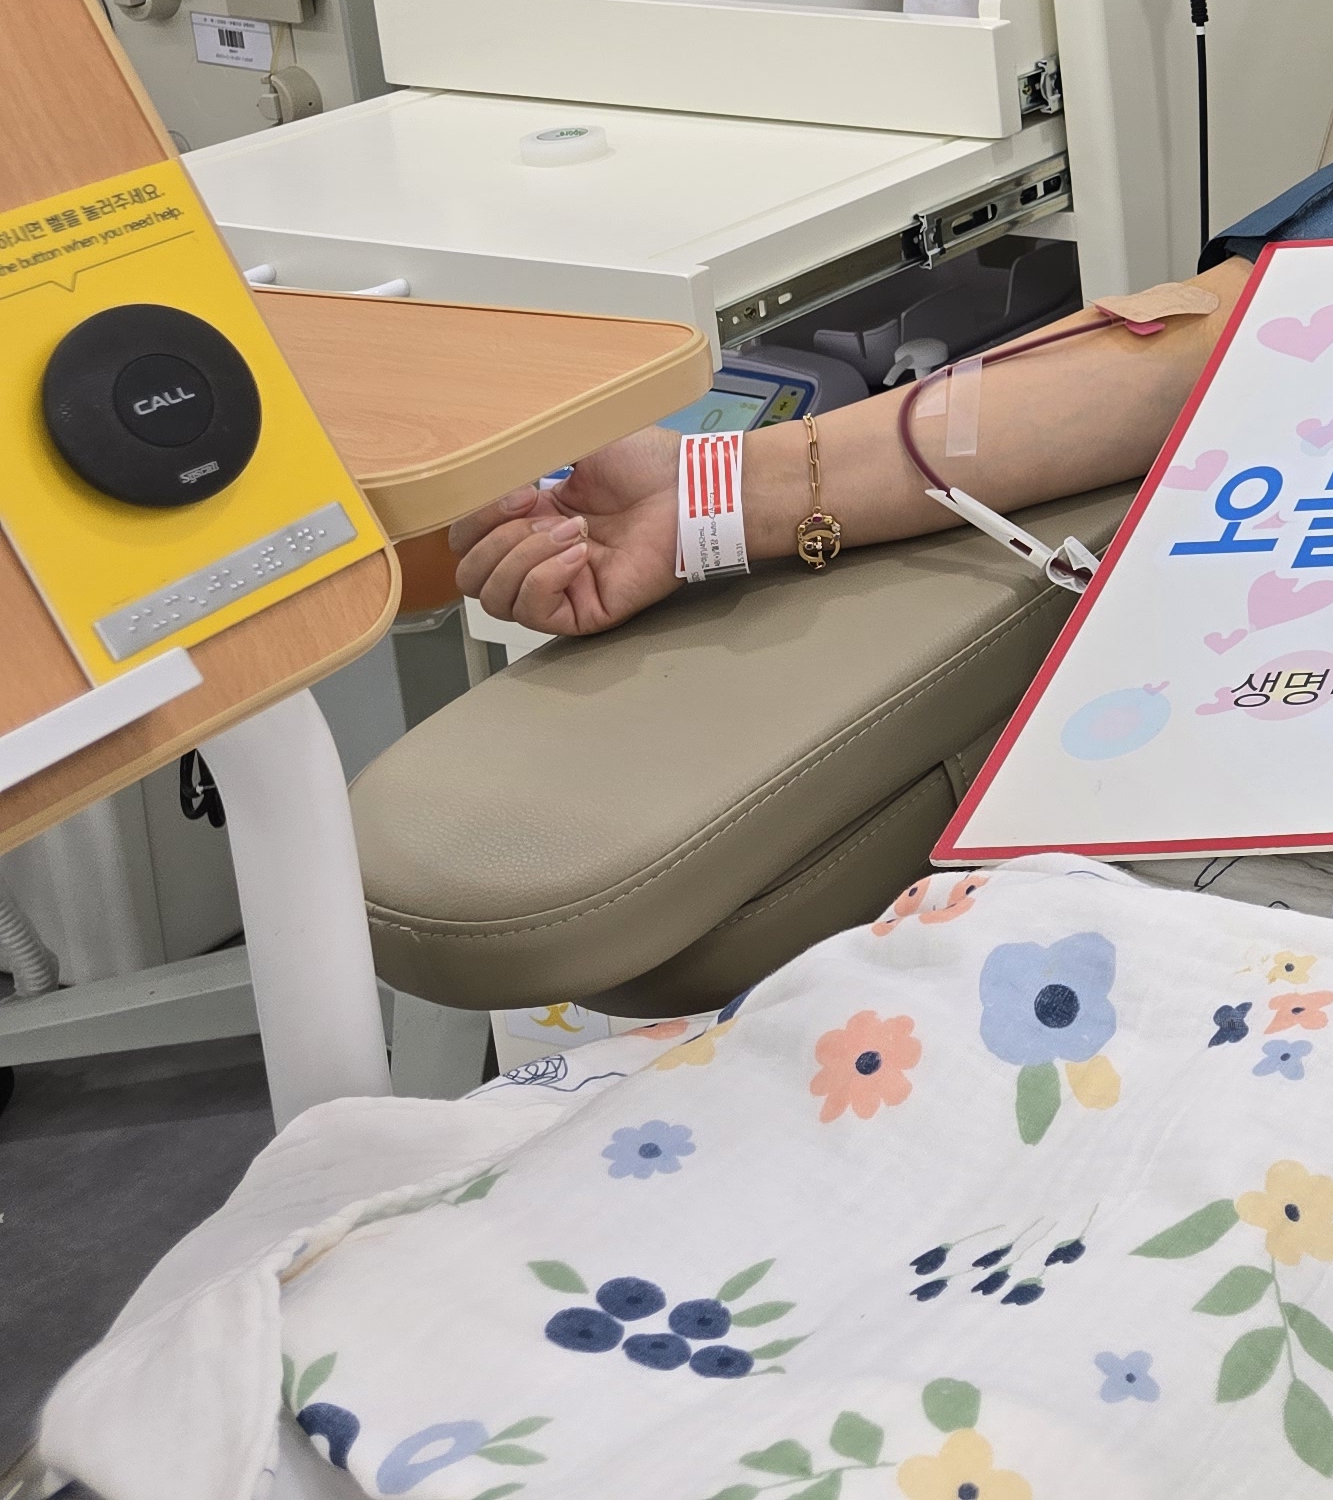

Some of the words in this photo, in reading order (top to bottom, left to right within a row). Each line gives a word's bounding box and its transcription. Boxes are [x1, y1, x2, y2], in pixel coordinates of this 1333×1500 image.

[44, 208, 84, 233] 벨을
[80, 183, 166, 222] 눌러주세요.
[17, 247, 63, 269] button
[61, 233, 98, 253] when
[98, 226, 125, 246] you
[124, 214, 155, 235] need
[154, 206, 185, 223] help.
[133, 387, 196, 416] CALL
